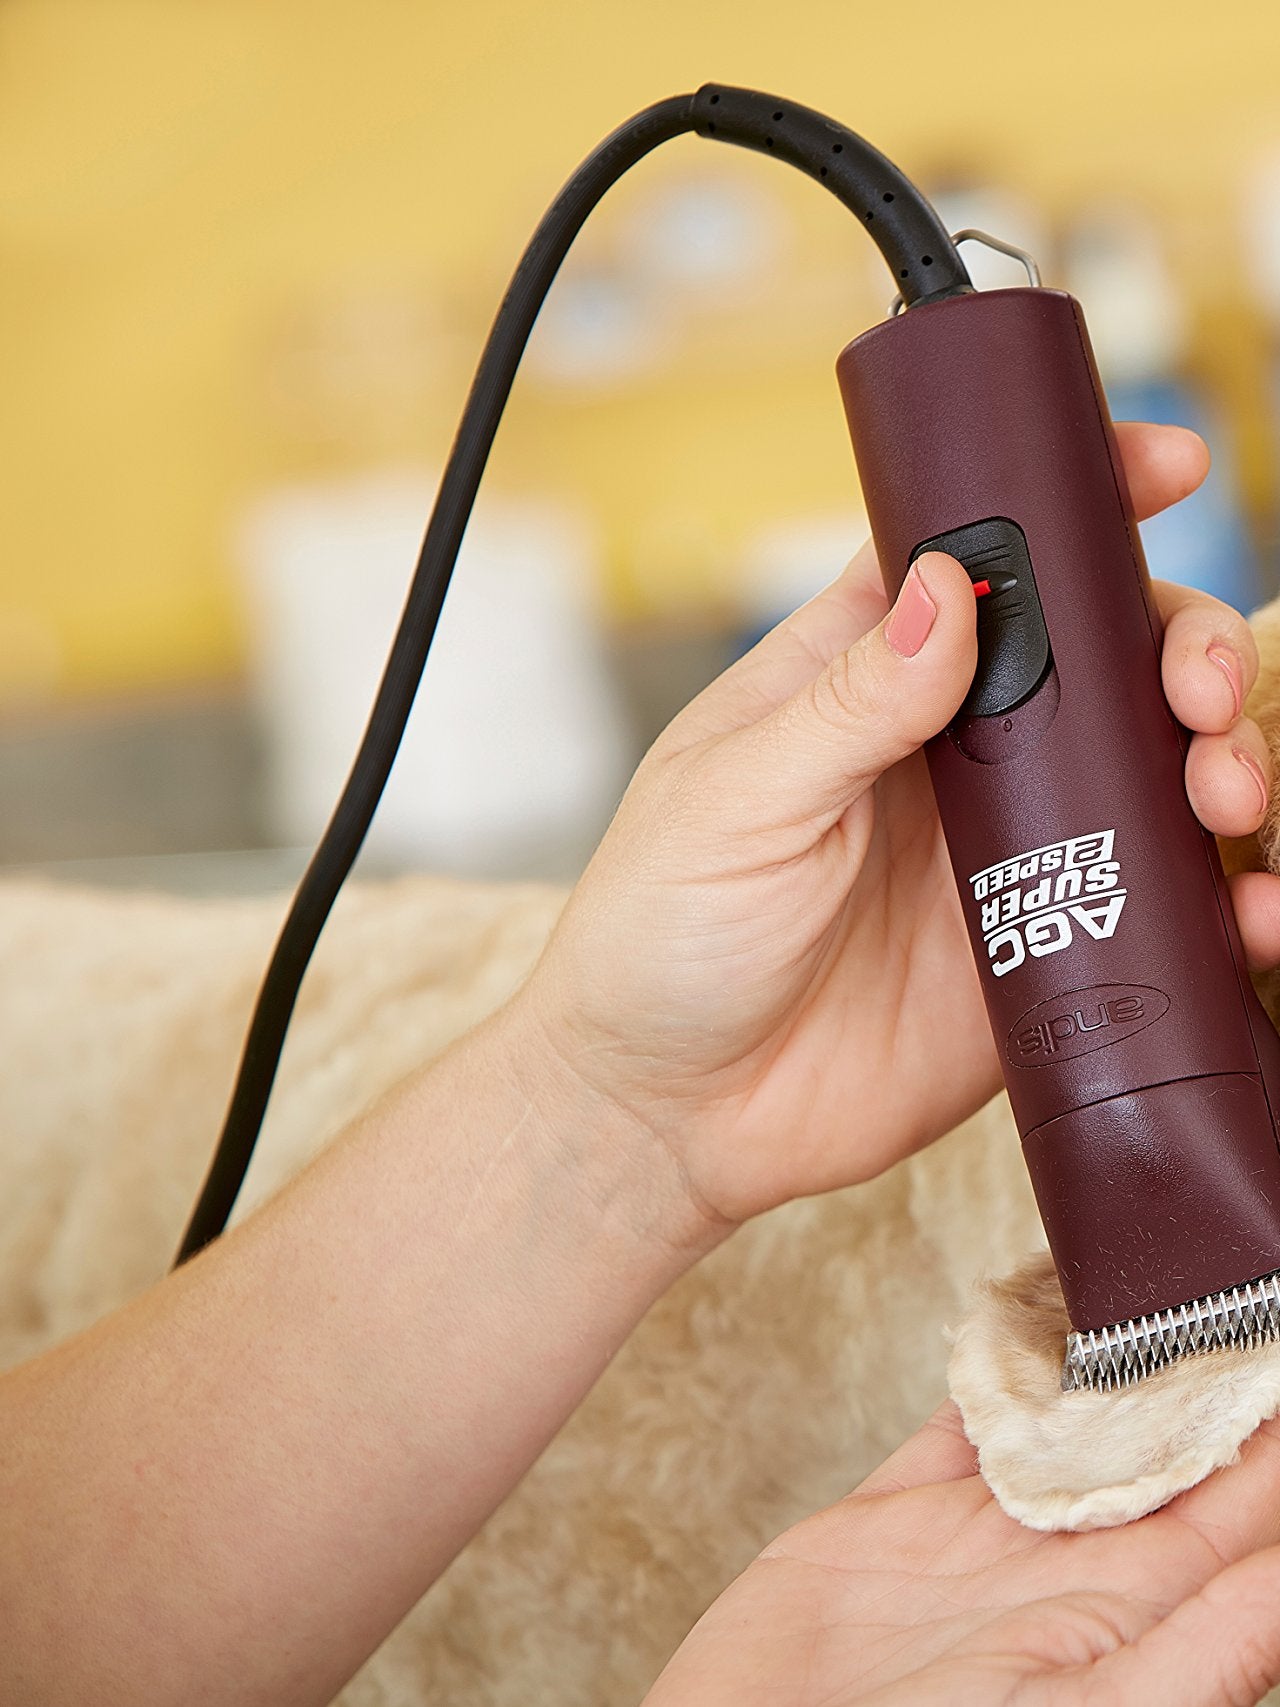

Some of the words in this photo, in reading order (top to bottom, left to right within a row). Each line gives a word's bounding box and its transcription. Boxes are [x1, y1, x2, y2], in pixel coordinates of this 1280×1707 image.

[974, 851, 1064, 901] SPEED
[981, 861, 1121, 932] SUPER
[988, 895, 1127, 977] AGC
[1016, 995, 1145, 1057] andis
